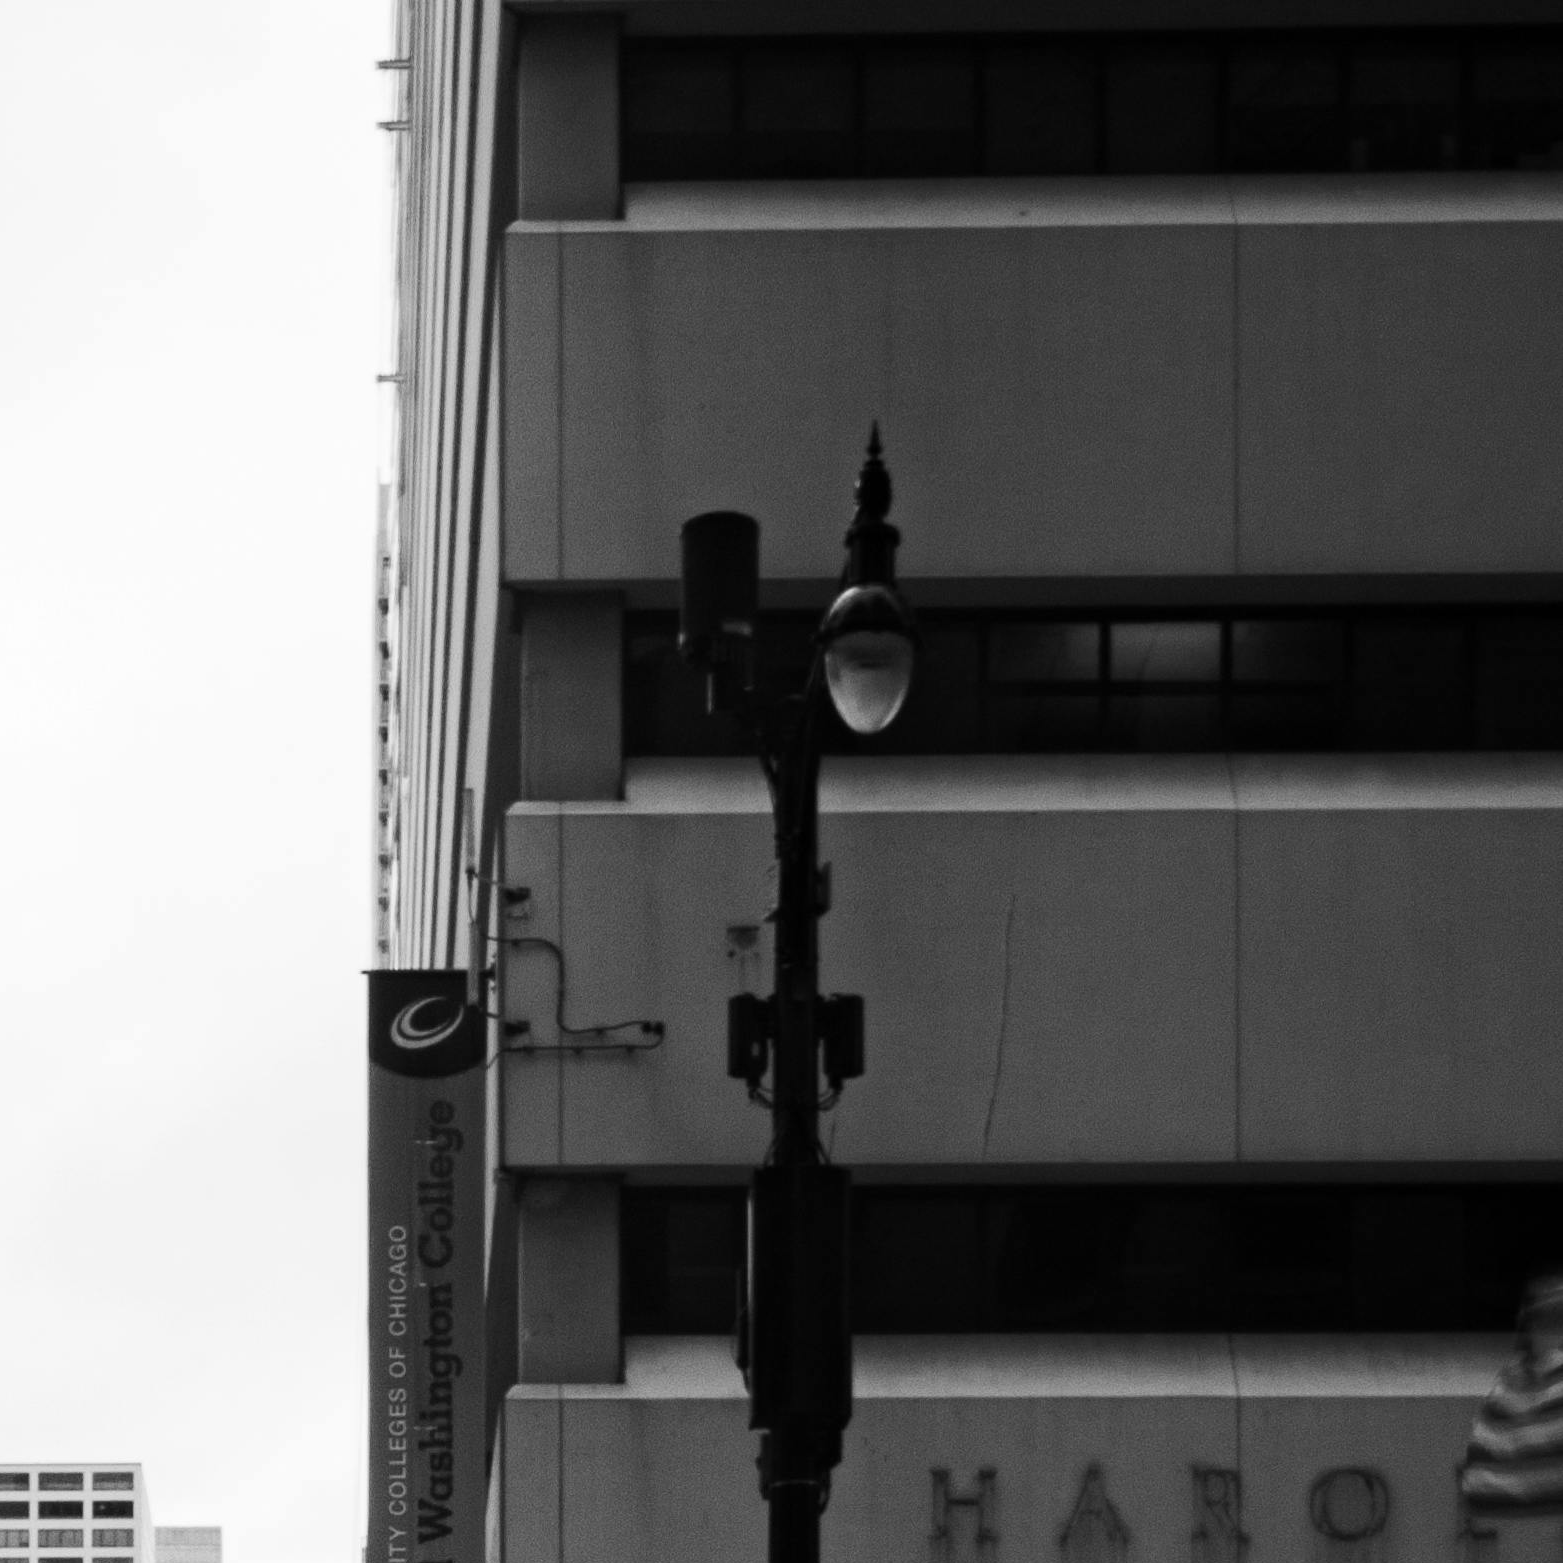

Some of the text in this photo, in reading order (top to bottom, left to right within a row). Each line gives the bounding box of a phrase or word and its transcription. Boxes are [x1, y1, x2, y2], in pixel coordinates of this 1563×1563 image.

[416, 1099, 464, 1269] College
[387, 1223, 408, 1337] CHICAGO
[387, 1344, 408, 1379] OF
[416, 1281, 464, 1544] Washington
[387, 1386, 408, 1516] COLLEGES
